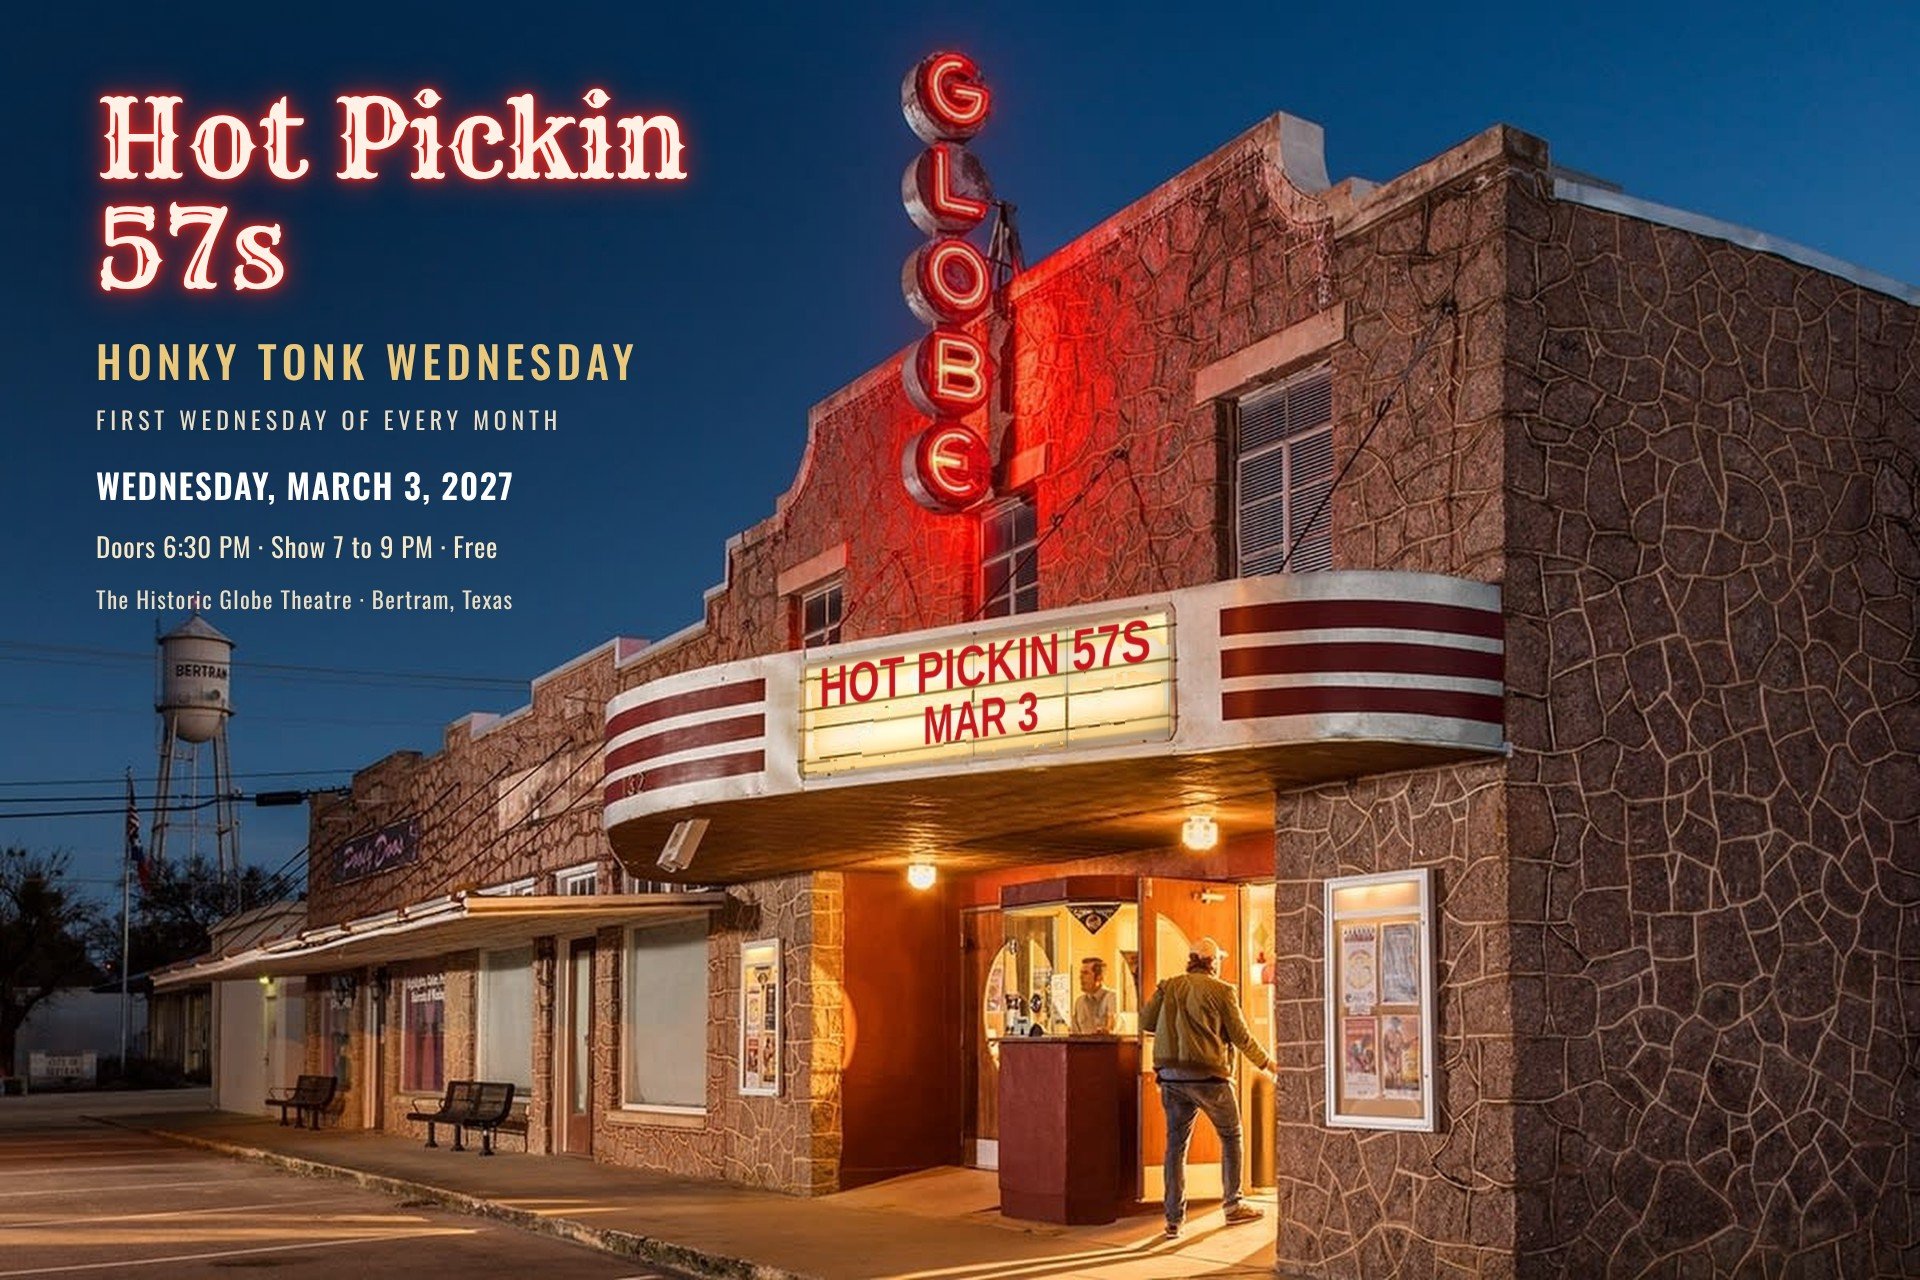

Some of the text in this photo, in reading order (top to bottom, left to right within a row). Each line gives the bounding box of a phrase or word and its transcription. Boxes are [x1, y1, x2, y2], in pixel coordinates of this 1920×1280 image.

[928, 52, 990, 494] GLOBE
[820, 620, 1151, 710] HOT PICKIN 57S
[924, 692, 1038, 745] MAR 3
